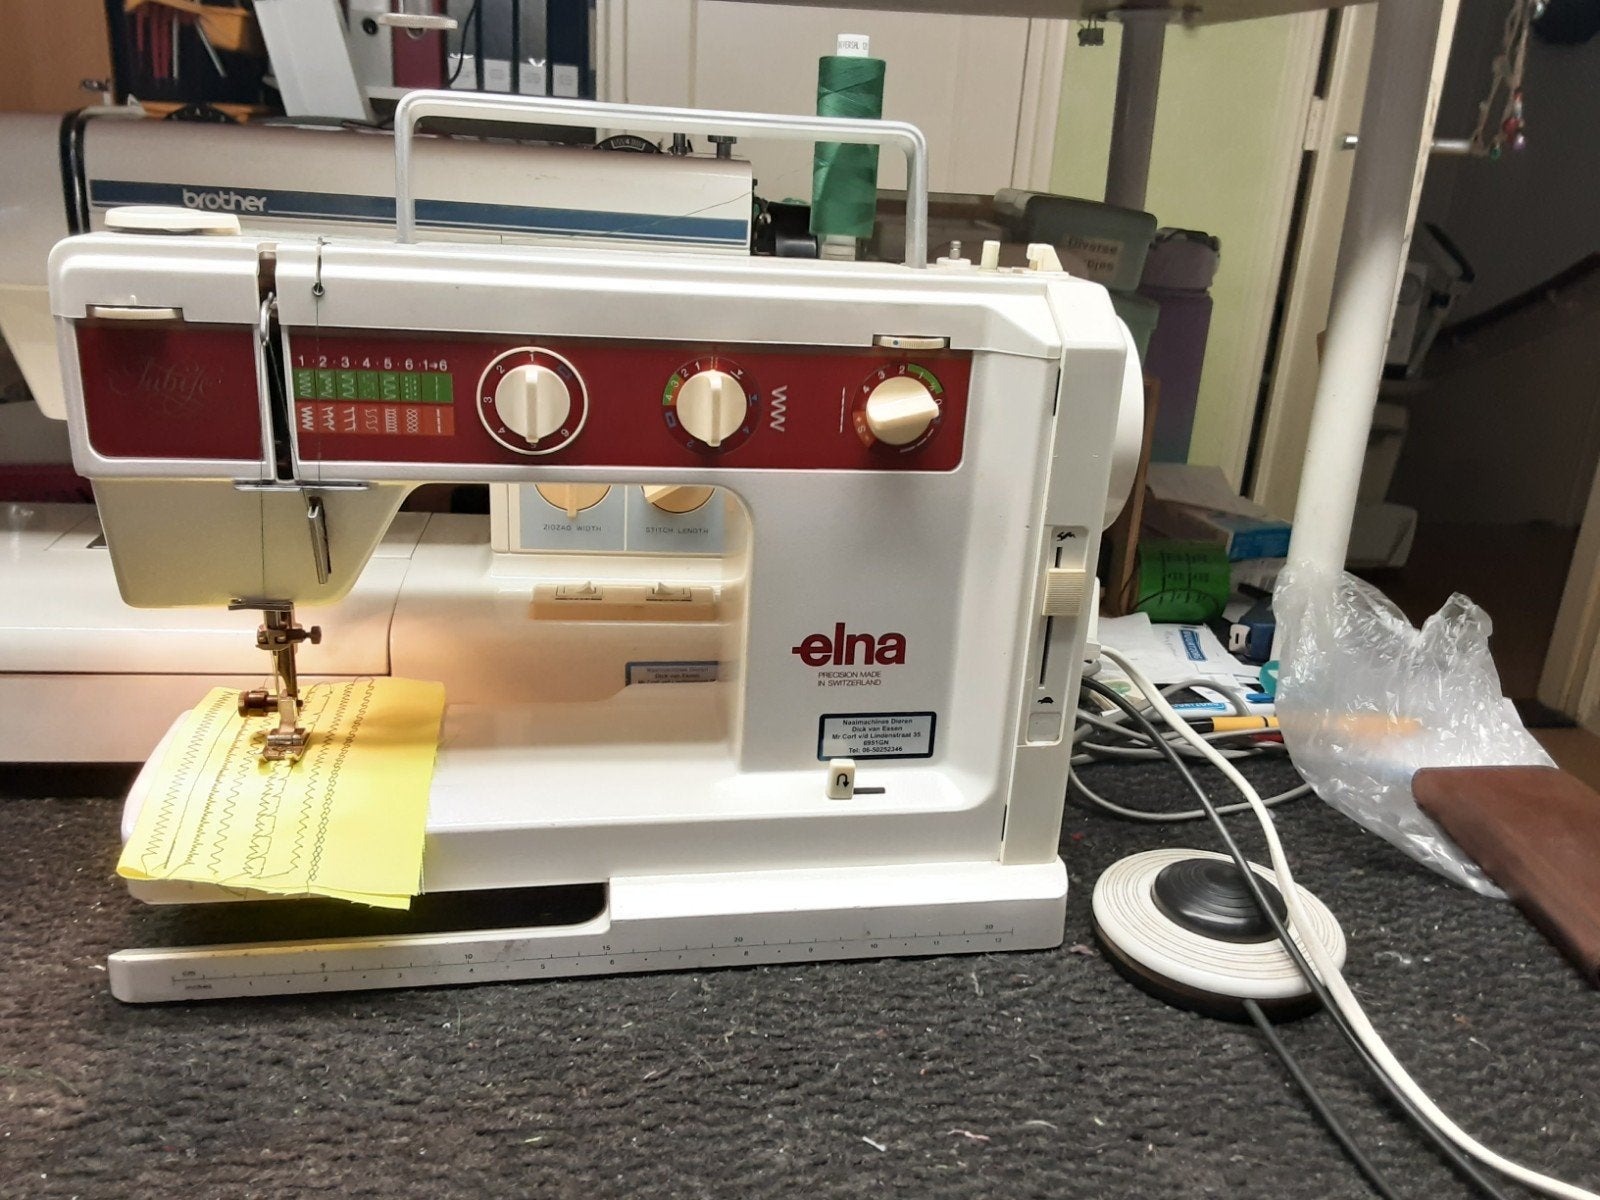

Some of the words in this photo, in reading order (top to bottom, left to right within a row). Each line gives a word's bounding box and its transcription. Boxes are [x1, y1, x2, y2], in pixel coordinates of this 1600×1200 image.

[182, 188, 267, 212] brother
[298, 354, 305, 367] 1
[319, 355, 327, 368] 2
[341, 356, 350, 368] 3
[362, 357, 371, 368] 4
[384, 358, 392, 369] 5
[405, 358, 413, 370] 6
[694, 361, 701, 371] 1
[496, 365, 505, 374] 2
[680, 368, 689, 377] 2
[877, 370, 886, 379] 3
[899, 365, 906, 375] 2
[483, 396, 492, 404] 3
[576, 525, 602, 533] WIDTH
[645, 526, 674, 535] STITCH
[677, 528, 709, 536] LENGTH
[791, 622, 906, 667] elna
[818, 671, 859, 679] PRECISION
[827, 678, 882, 687] SWITZERLAND
